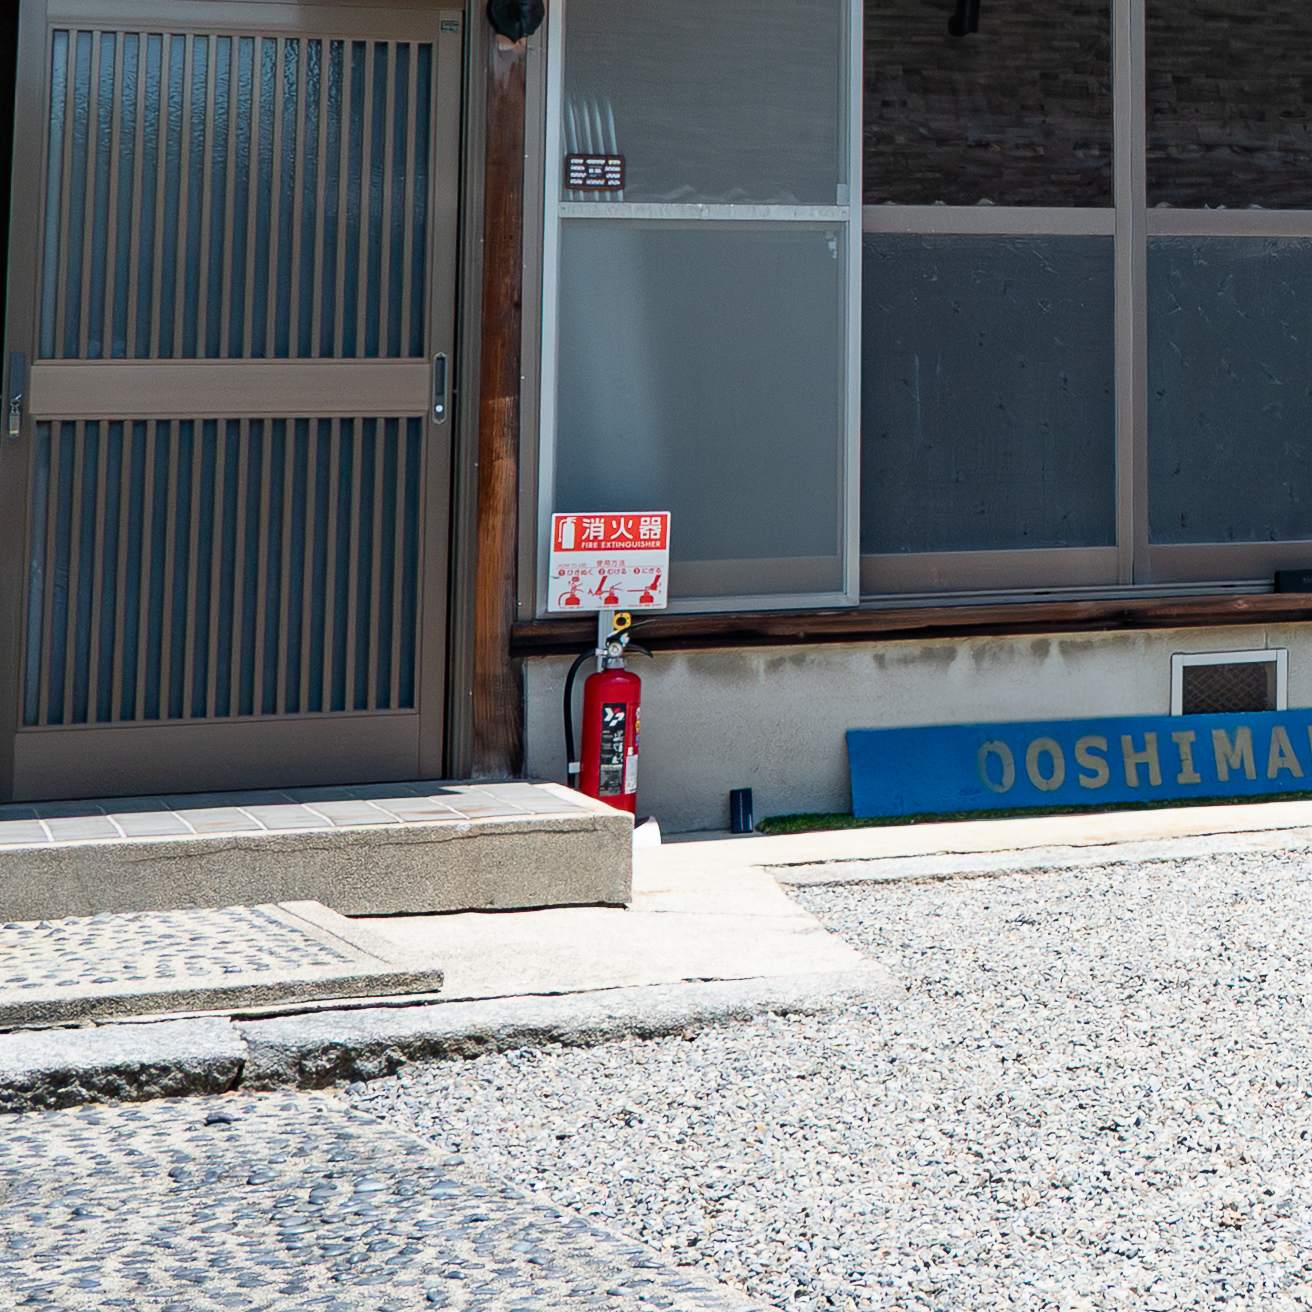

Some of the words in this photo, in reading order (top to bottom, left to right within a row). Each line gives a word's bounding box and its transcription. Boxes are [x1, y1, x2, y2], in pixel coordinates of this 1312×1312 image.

[581, 517, 662, 540] 消火器
[581, 541, 598, 549] FIRE
[601, 540, 661, 549] EXTINGUISHER
[596, 559, 626, 568] 使用方法
